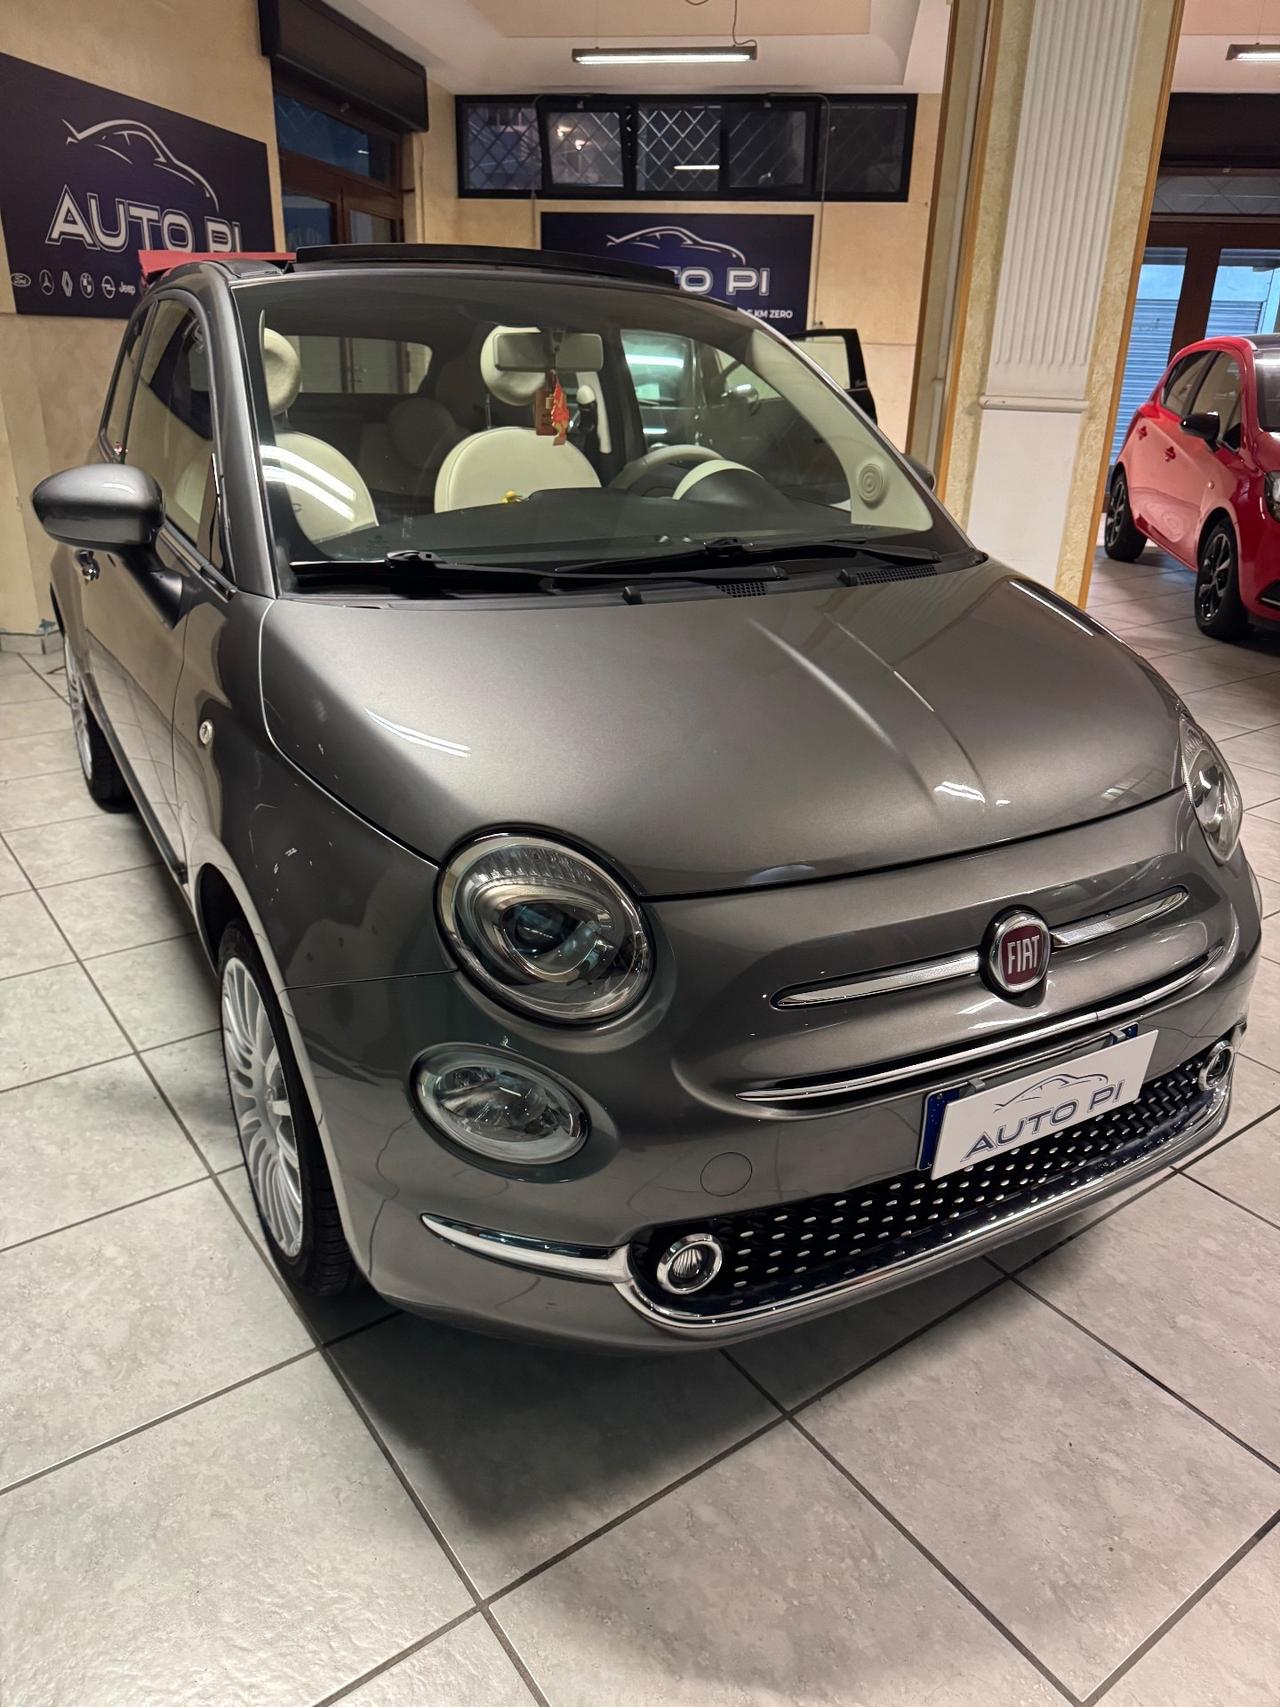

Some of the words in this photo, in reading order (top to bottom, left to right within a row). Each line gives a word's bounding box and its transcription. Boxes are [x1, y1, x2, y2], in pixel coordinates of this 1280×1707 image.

[45, 184, 195, 253] AUTO
[204, 216, 241, 253] PI
[119, 281, 136, 296] Jeep
[726, 267, 770, 296] PI
[754, 309, 768, 318] KM
[769, 309, 794, 319] ZERO
[1007, 934, 1040, 975] FIAT
[960, 1099, 1079, 1162] AUTO
[1087, 1080, 1125, 1113] PI
